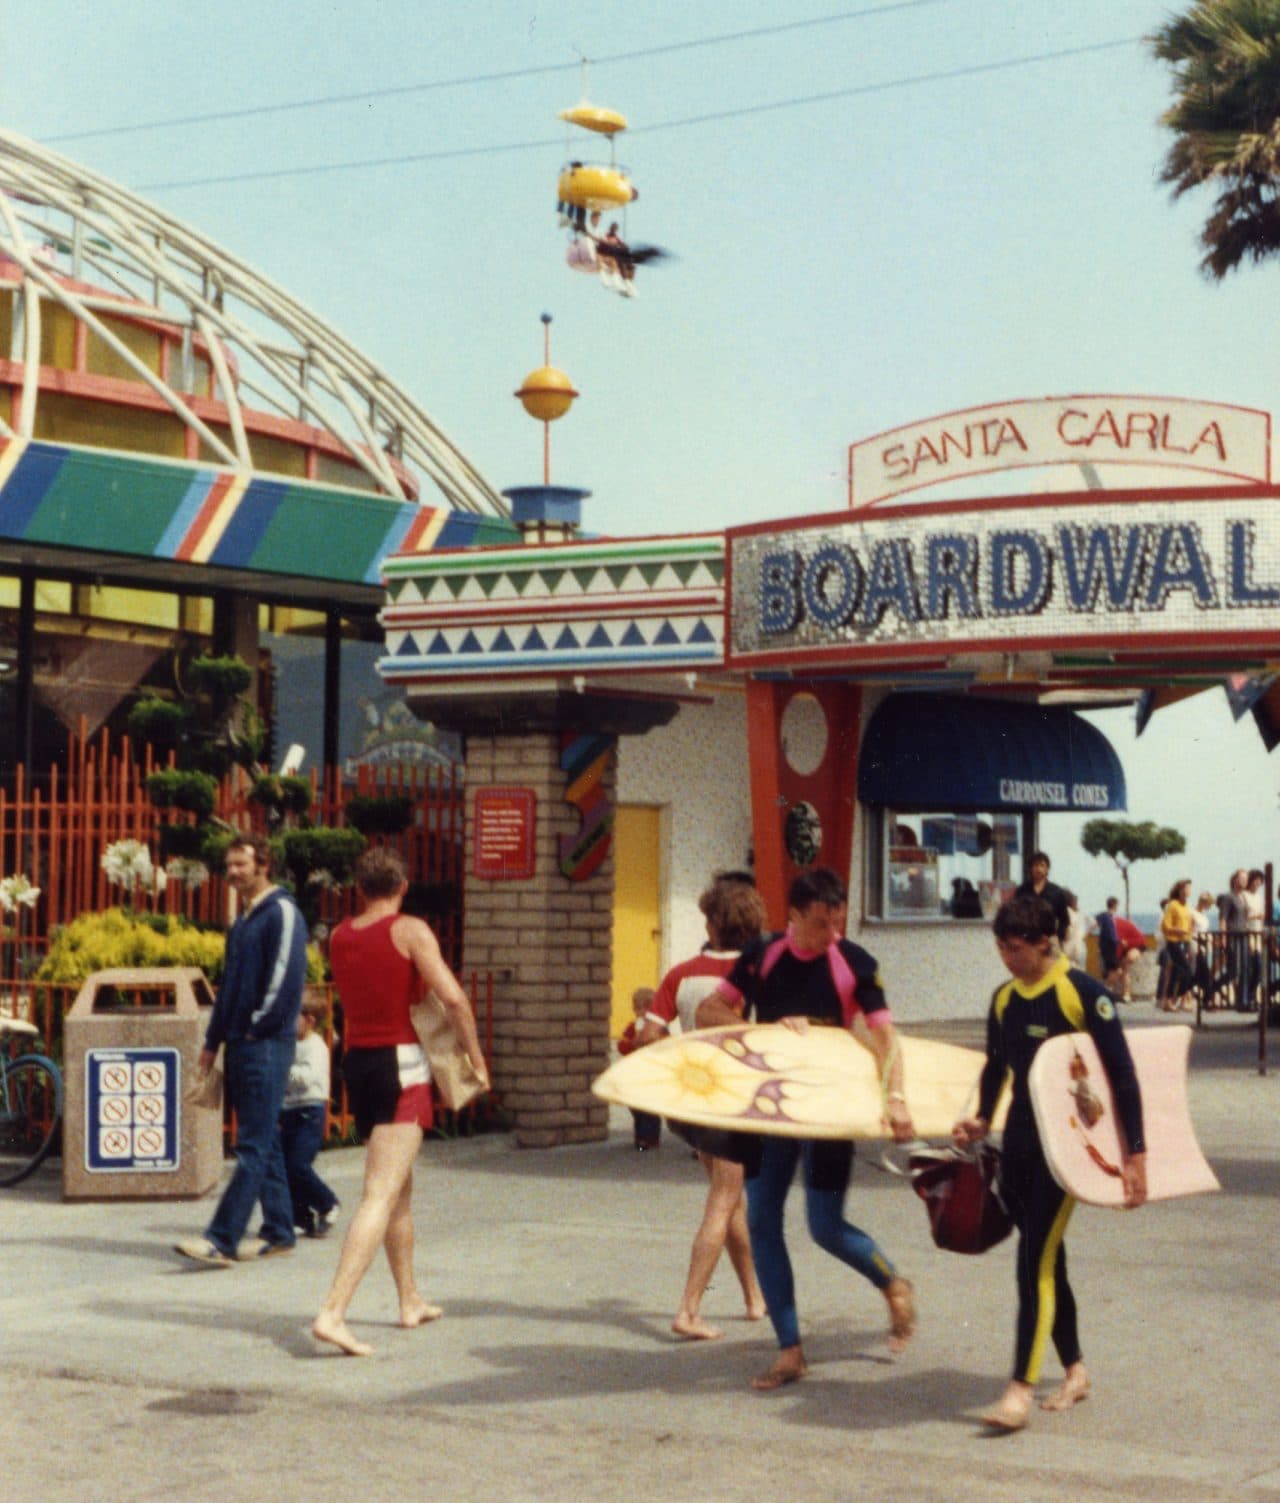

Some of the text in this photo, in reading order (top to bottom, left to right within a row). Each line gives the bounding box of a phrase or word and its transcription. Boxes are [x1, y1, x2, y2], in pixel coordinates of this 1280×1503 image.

[881, 409, 1226, 480] SANTA CARLA
[1000, 779, 1109, 808] CARROUSEL CONES
